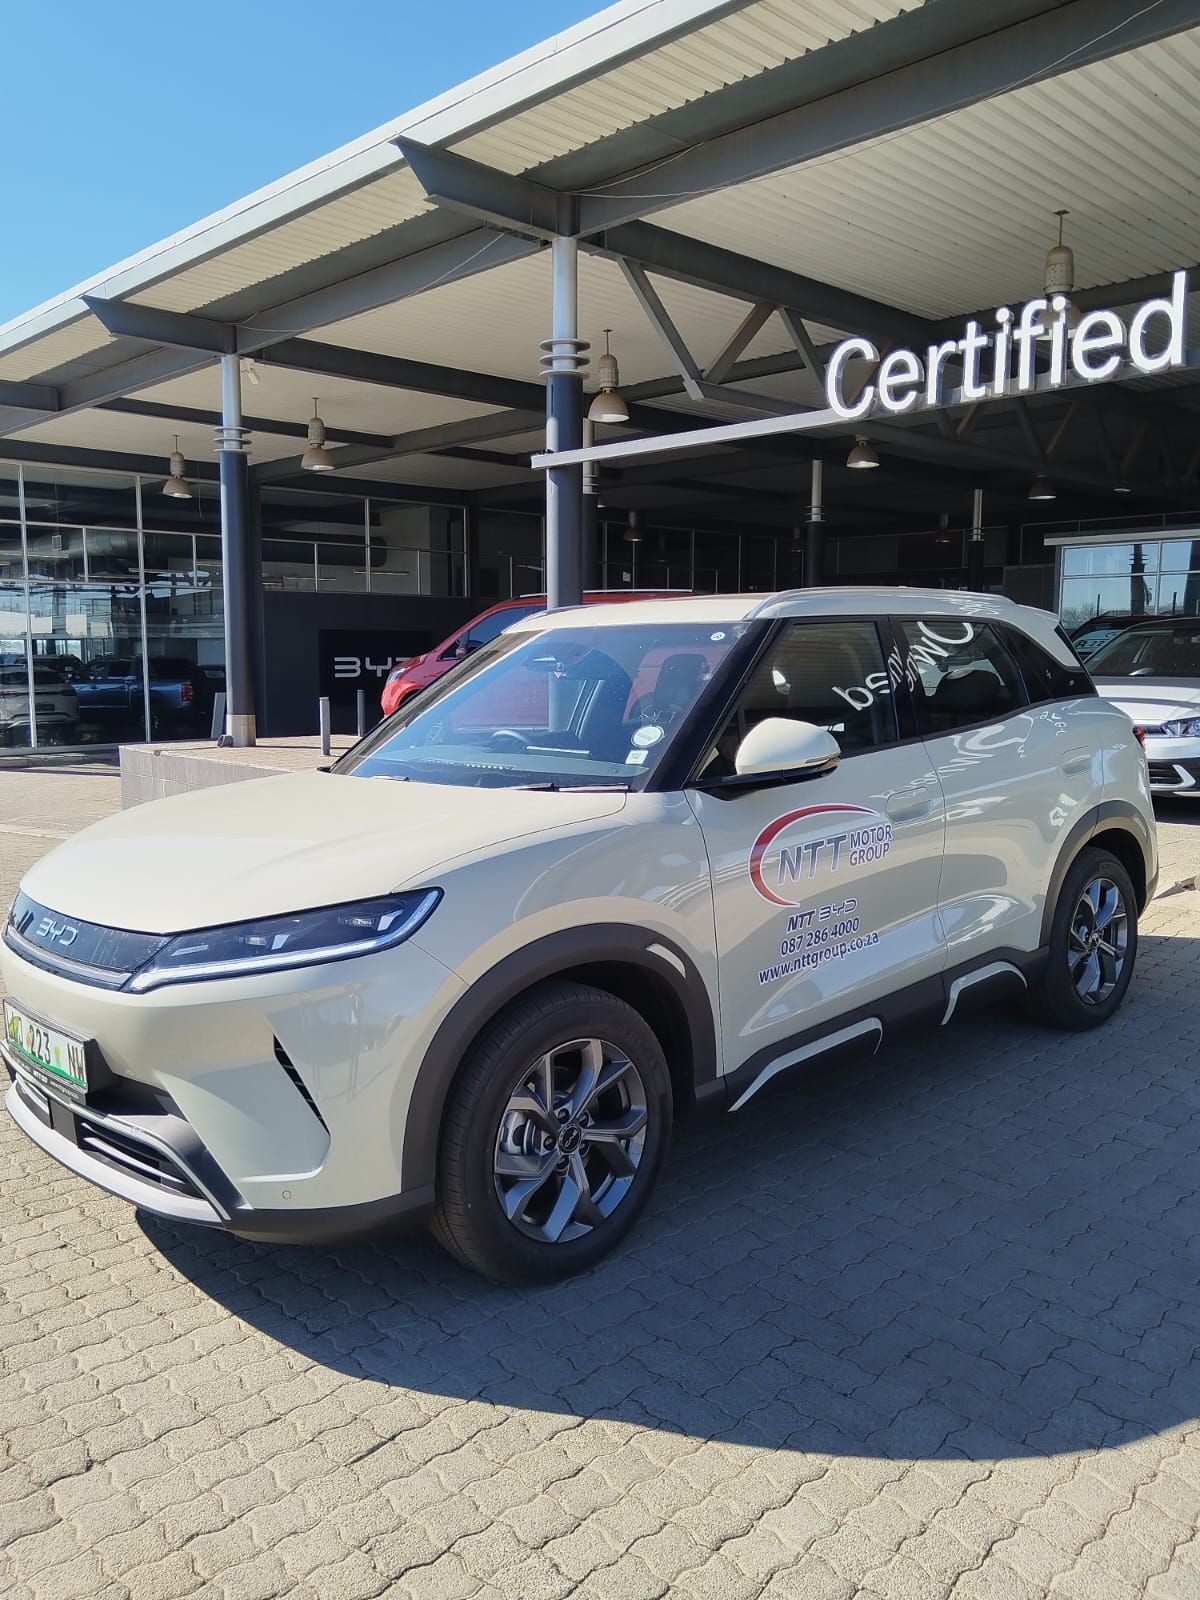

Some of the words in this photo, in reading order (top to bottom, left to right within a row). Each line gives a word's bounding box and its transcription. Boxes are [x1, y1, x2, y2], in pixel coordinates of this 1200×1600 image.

[826, 270, 1187, 418] Certified
[334, 657, 412, 678] BY
[850, 824, 892, 848] MOTOR
[778, 833, 847, 885] NTT
[850, 842, 890, 867] GROUP
[37, 917, 78, 946] BYD
[787, 909, 815, 932] NTT
[819, 899, 858, 921] BYD
[781, 932, 803, 956] 087
[806, 926, 829, 947] 286
[831, 917, 860, 939] 4000
[758, 930, 880, 985] www.nttgroup.co.za
[29, 1023, 51, 1064] 223
